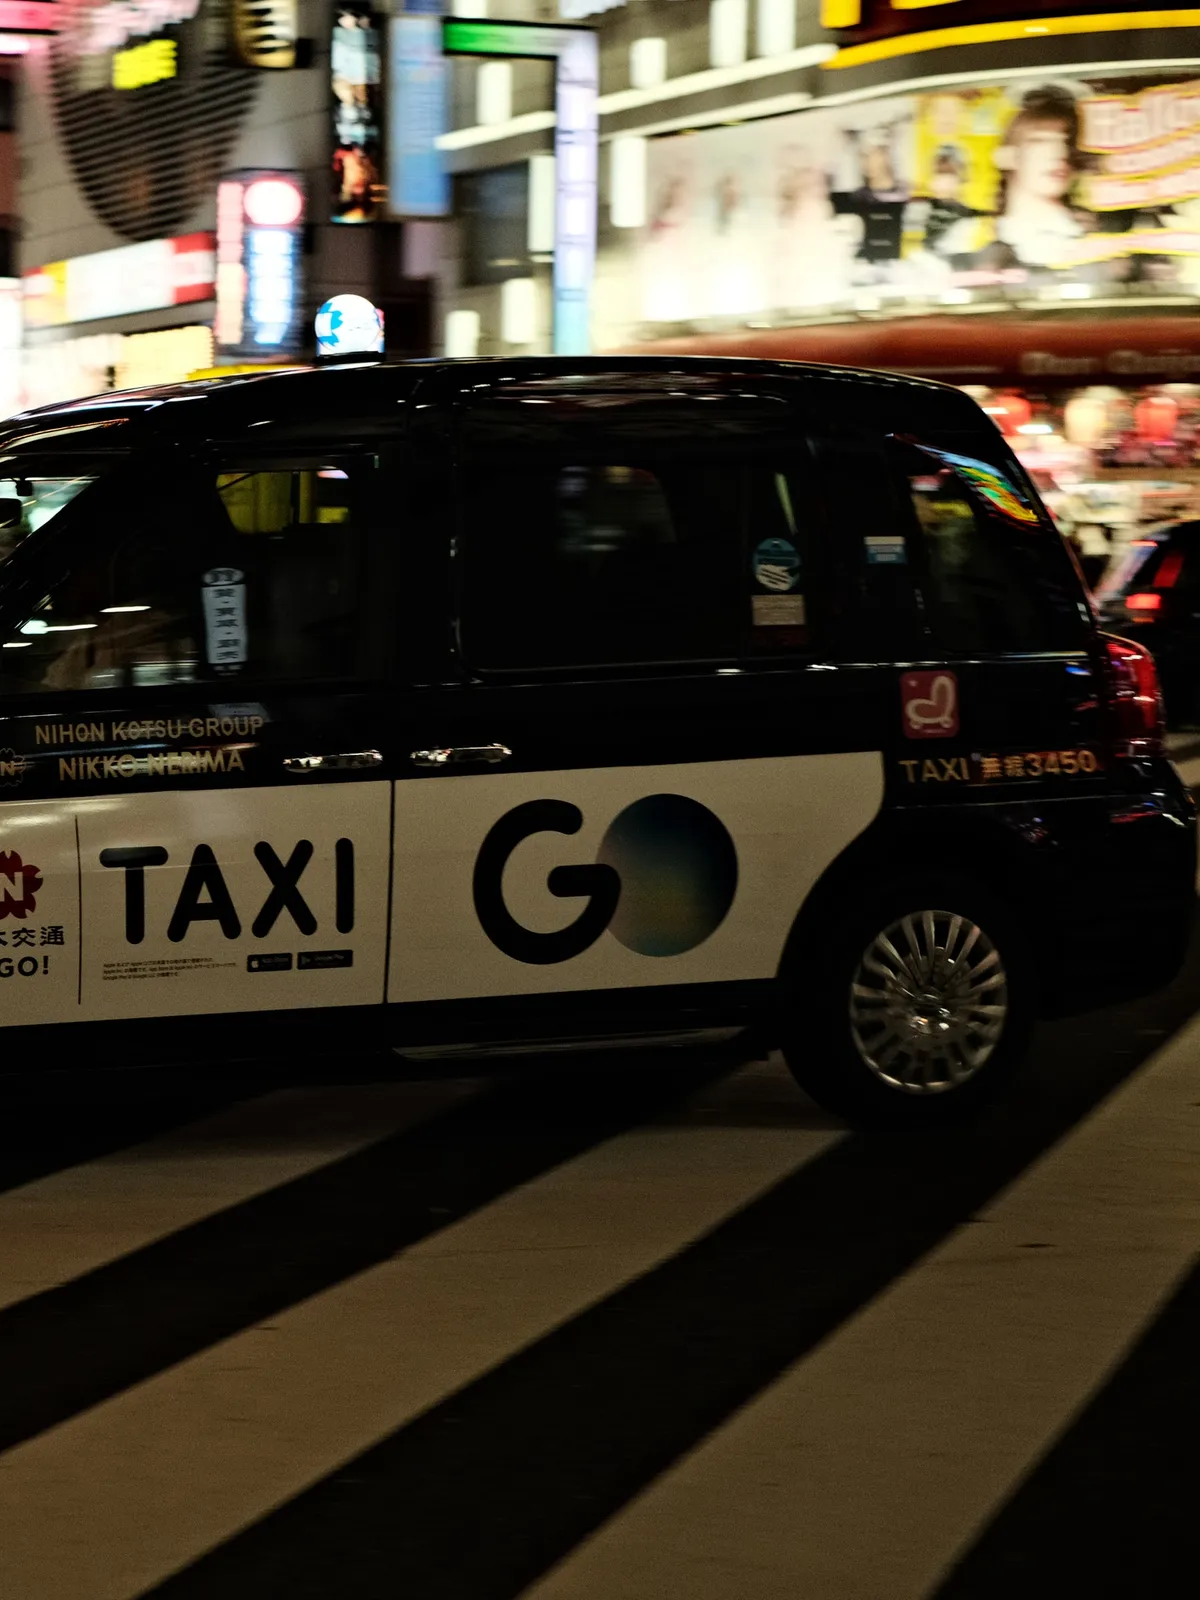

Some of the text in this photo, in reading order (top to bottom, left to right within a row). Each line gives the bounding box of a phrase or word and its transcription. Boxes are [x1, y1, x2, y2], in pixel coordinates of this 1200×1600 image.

[35, 716, 264, 745] NIHON KOTSU GROUP
[58, 750, 245, 781] NIKKO NERIMA
[898, 757, 970, 784] TAXI
[100, 838, 354, 944] TAXI
[473, 794, 738, 964] GO
